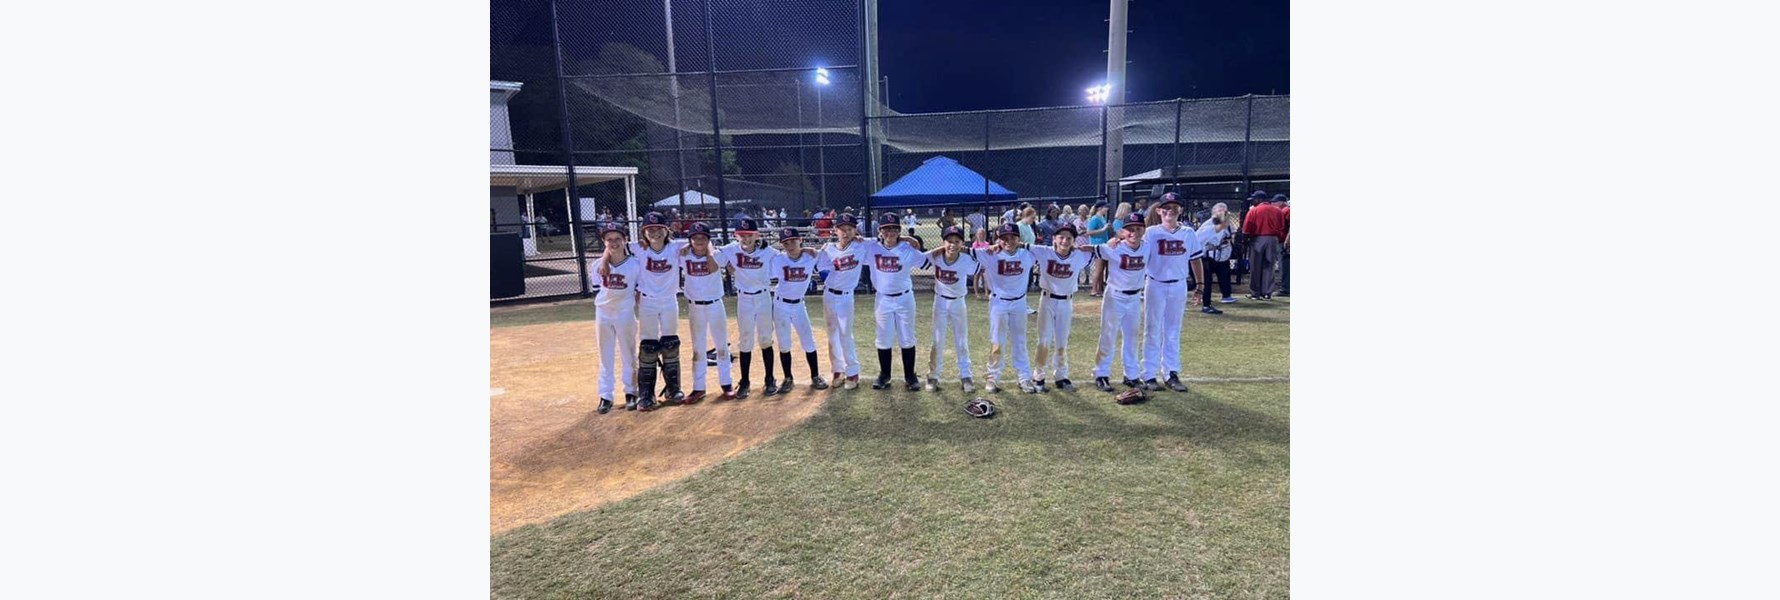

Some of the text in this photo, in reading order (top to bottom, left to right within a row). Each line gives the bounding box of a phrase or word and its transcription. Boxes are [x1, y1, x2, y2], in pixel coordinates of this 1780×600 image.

[1157, 239, 1186, 256] LEE
[875, 254, 902, 272] LEE
[998, 259, 1023, 276] LEE
[1047, 259, 1073, 278] LEE
[1119, 254, 1145, 271] LEE
